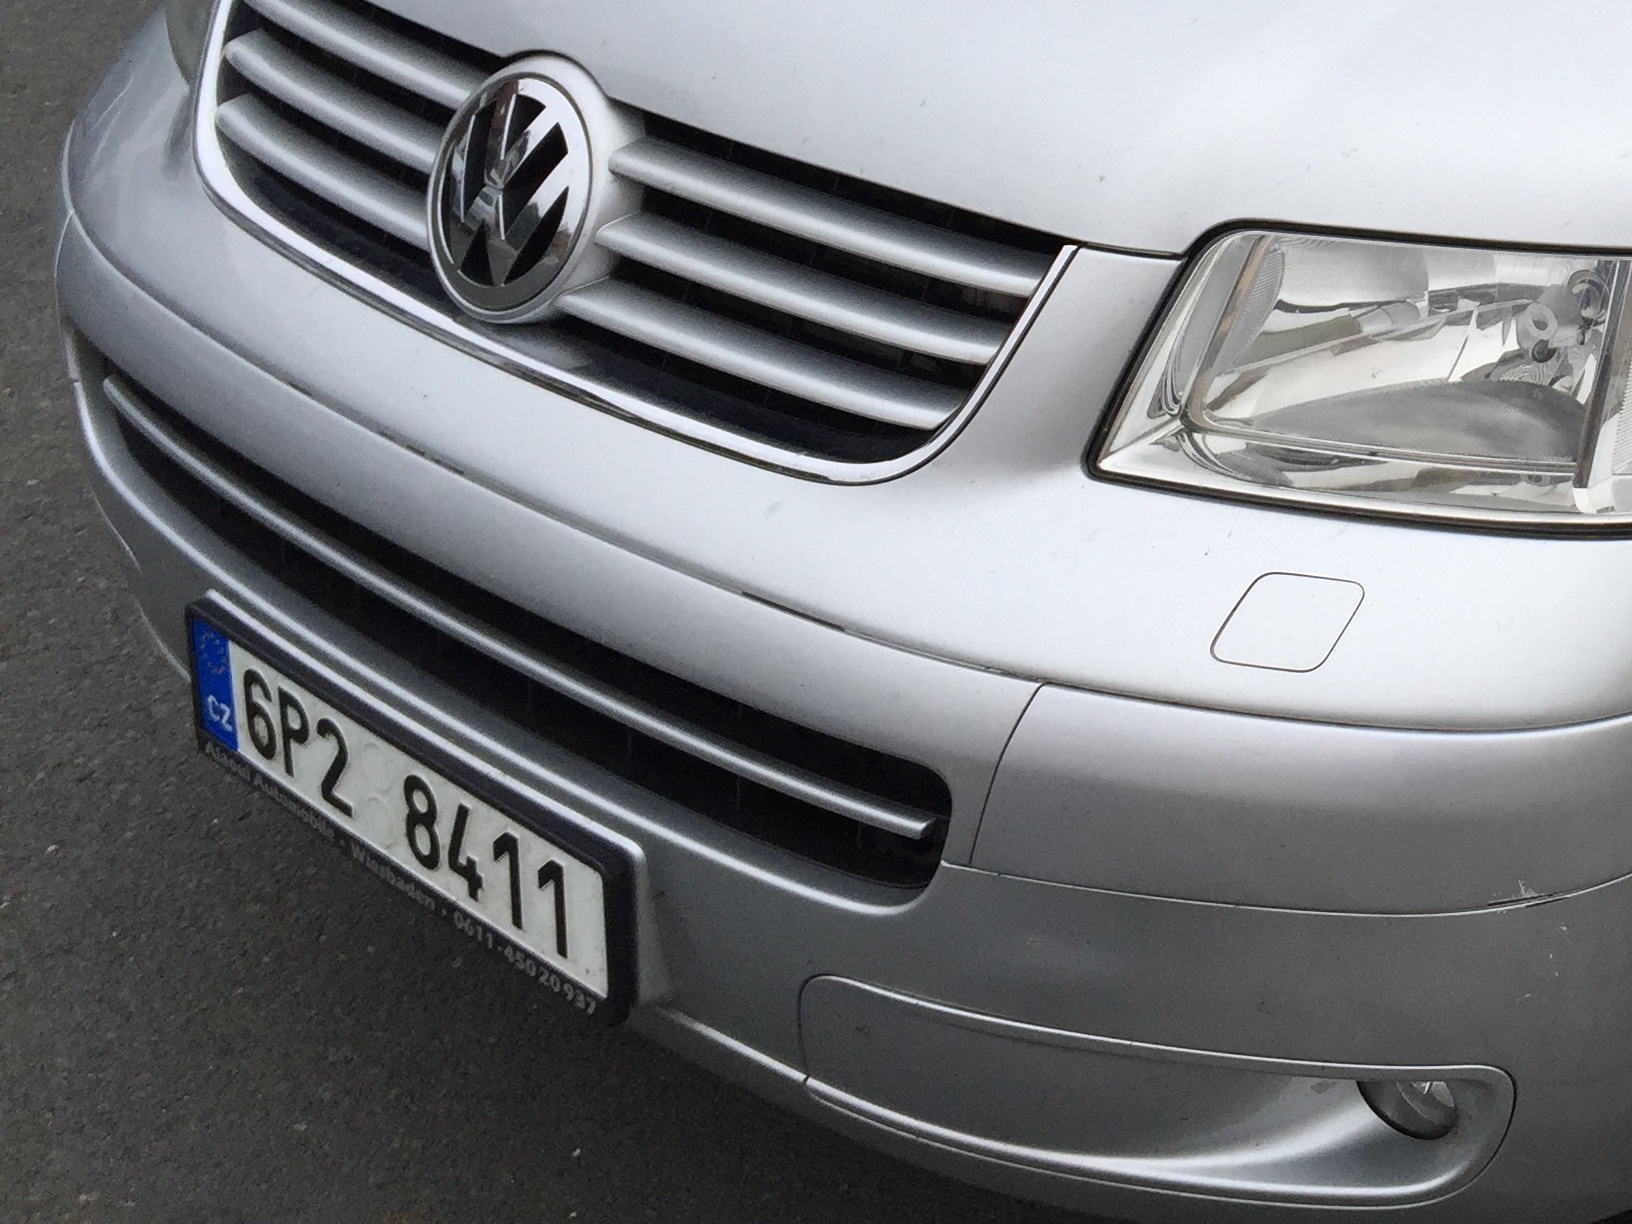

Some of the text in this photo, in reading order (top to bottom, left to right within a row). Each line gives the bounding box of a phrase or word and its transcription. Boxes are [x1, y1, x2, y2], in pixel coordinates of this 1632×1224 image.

[207, 694, 233, 733] CZ
[243, 668, 568, 959] 6P2 8411
